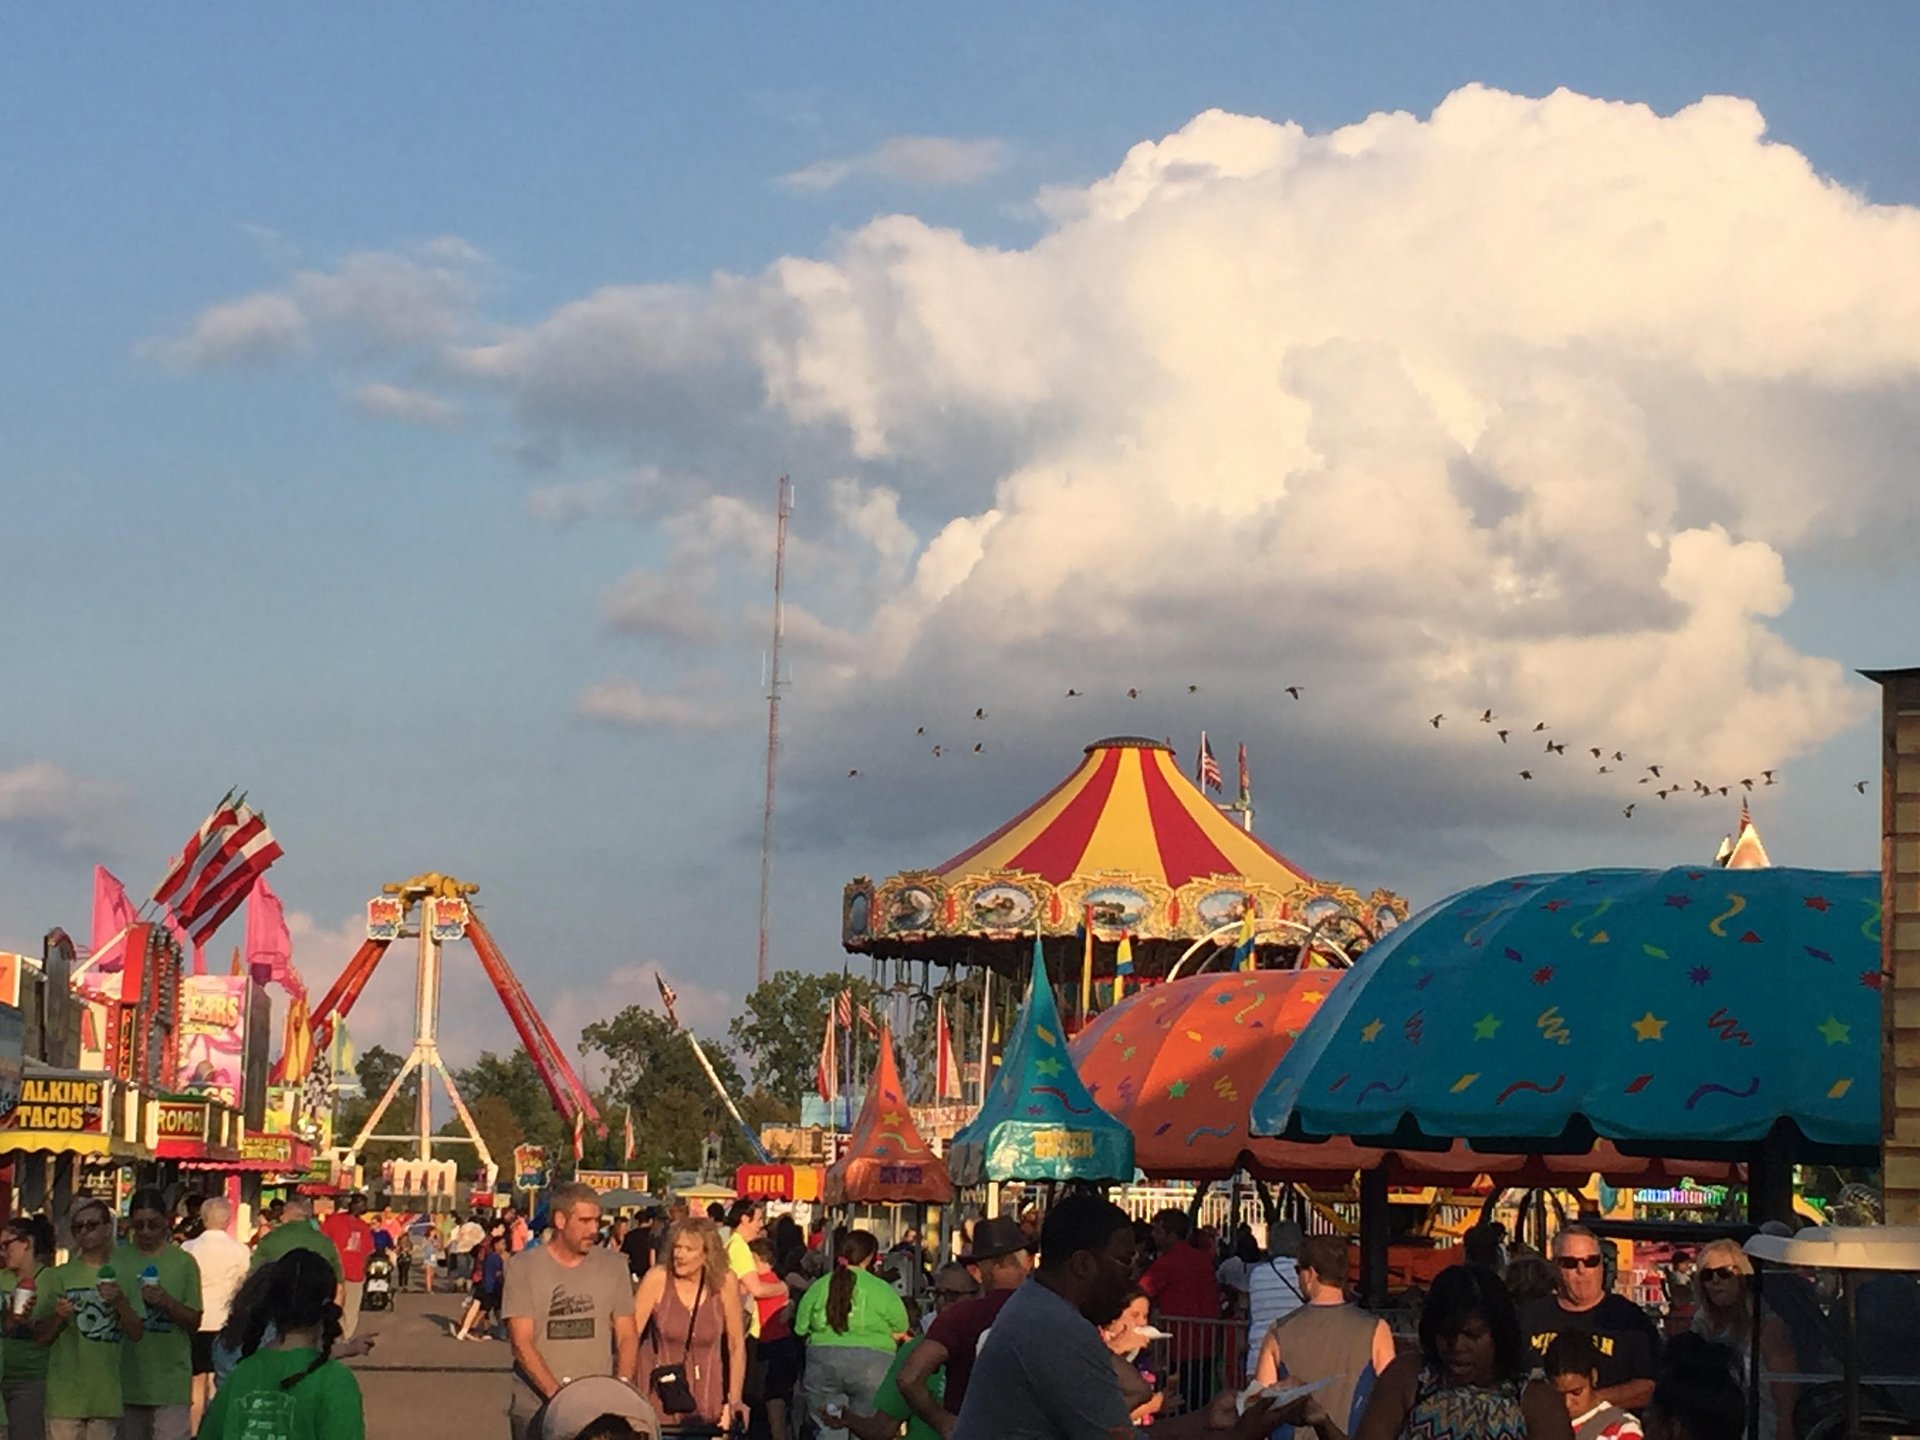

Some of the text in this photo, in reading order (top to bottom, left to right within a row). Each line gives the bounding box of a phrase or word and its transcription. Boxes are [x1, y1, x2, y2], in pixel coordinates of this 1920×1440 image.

[20, 1080, 99, 1104] ALKING
[17, 1105, 84, 1129] TACOS
[747, 1174, 784, 1193] ENTER
